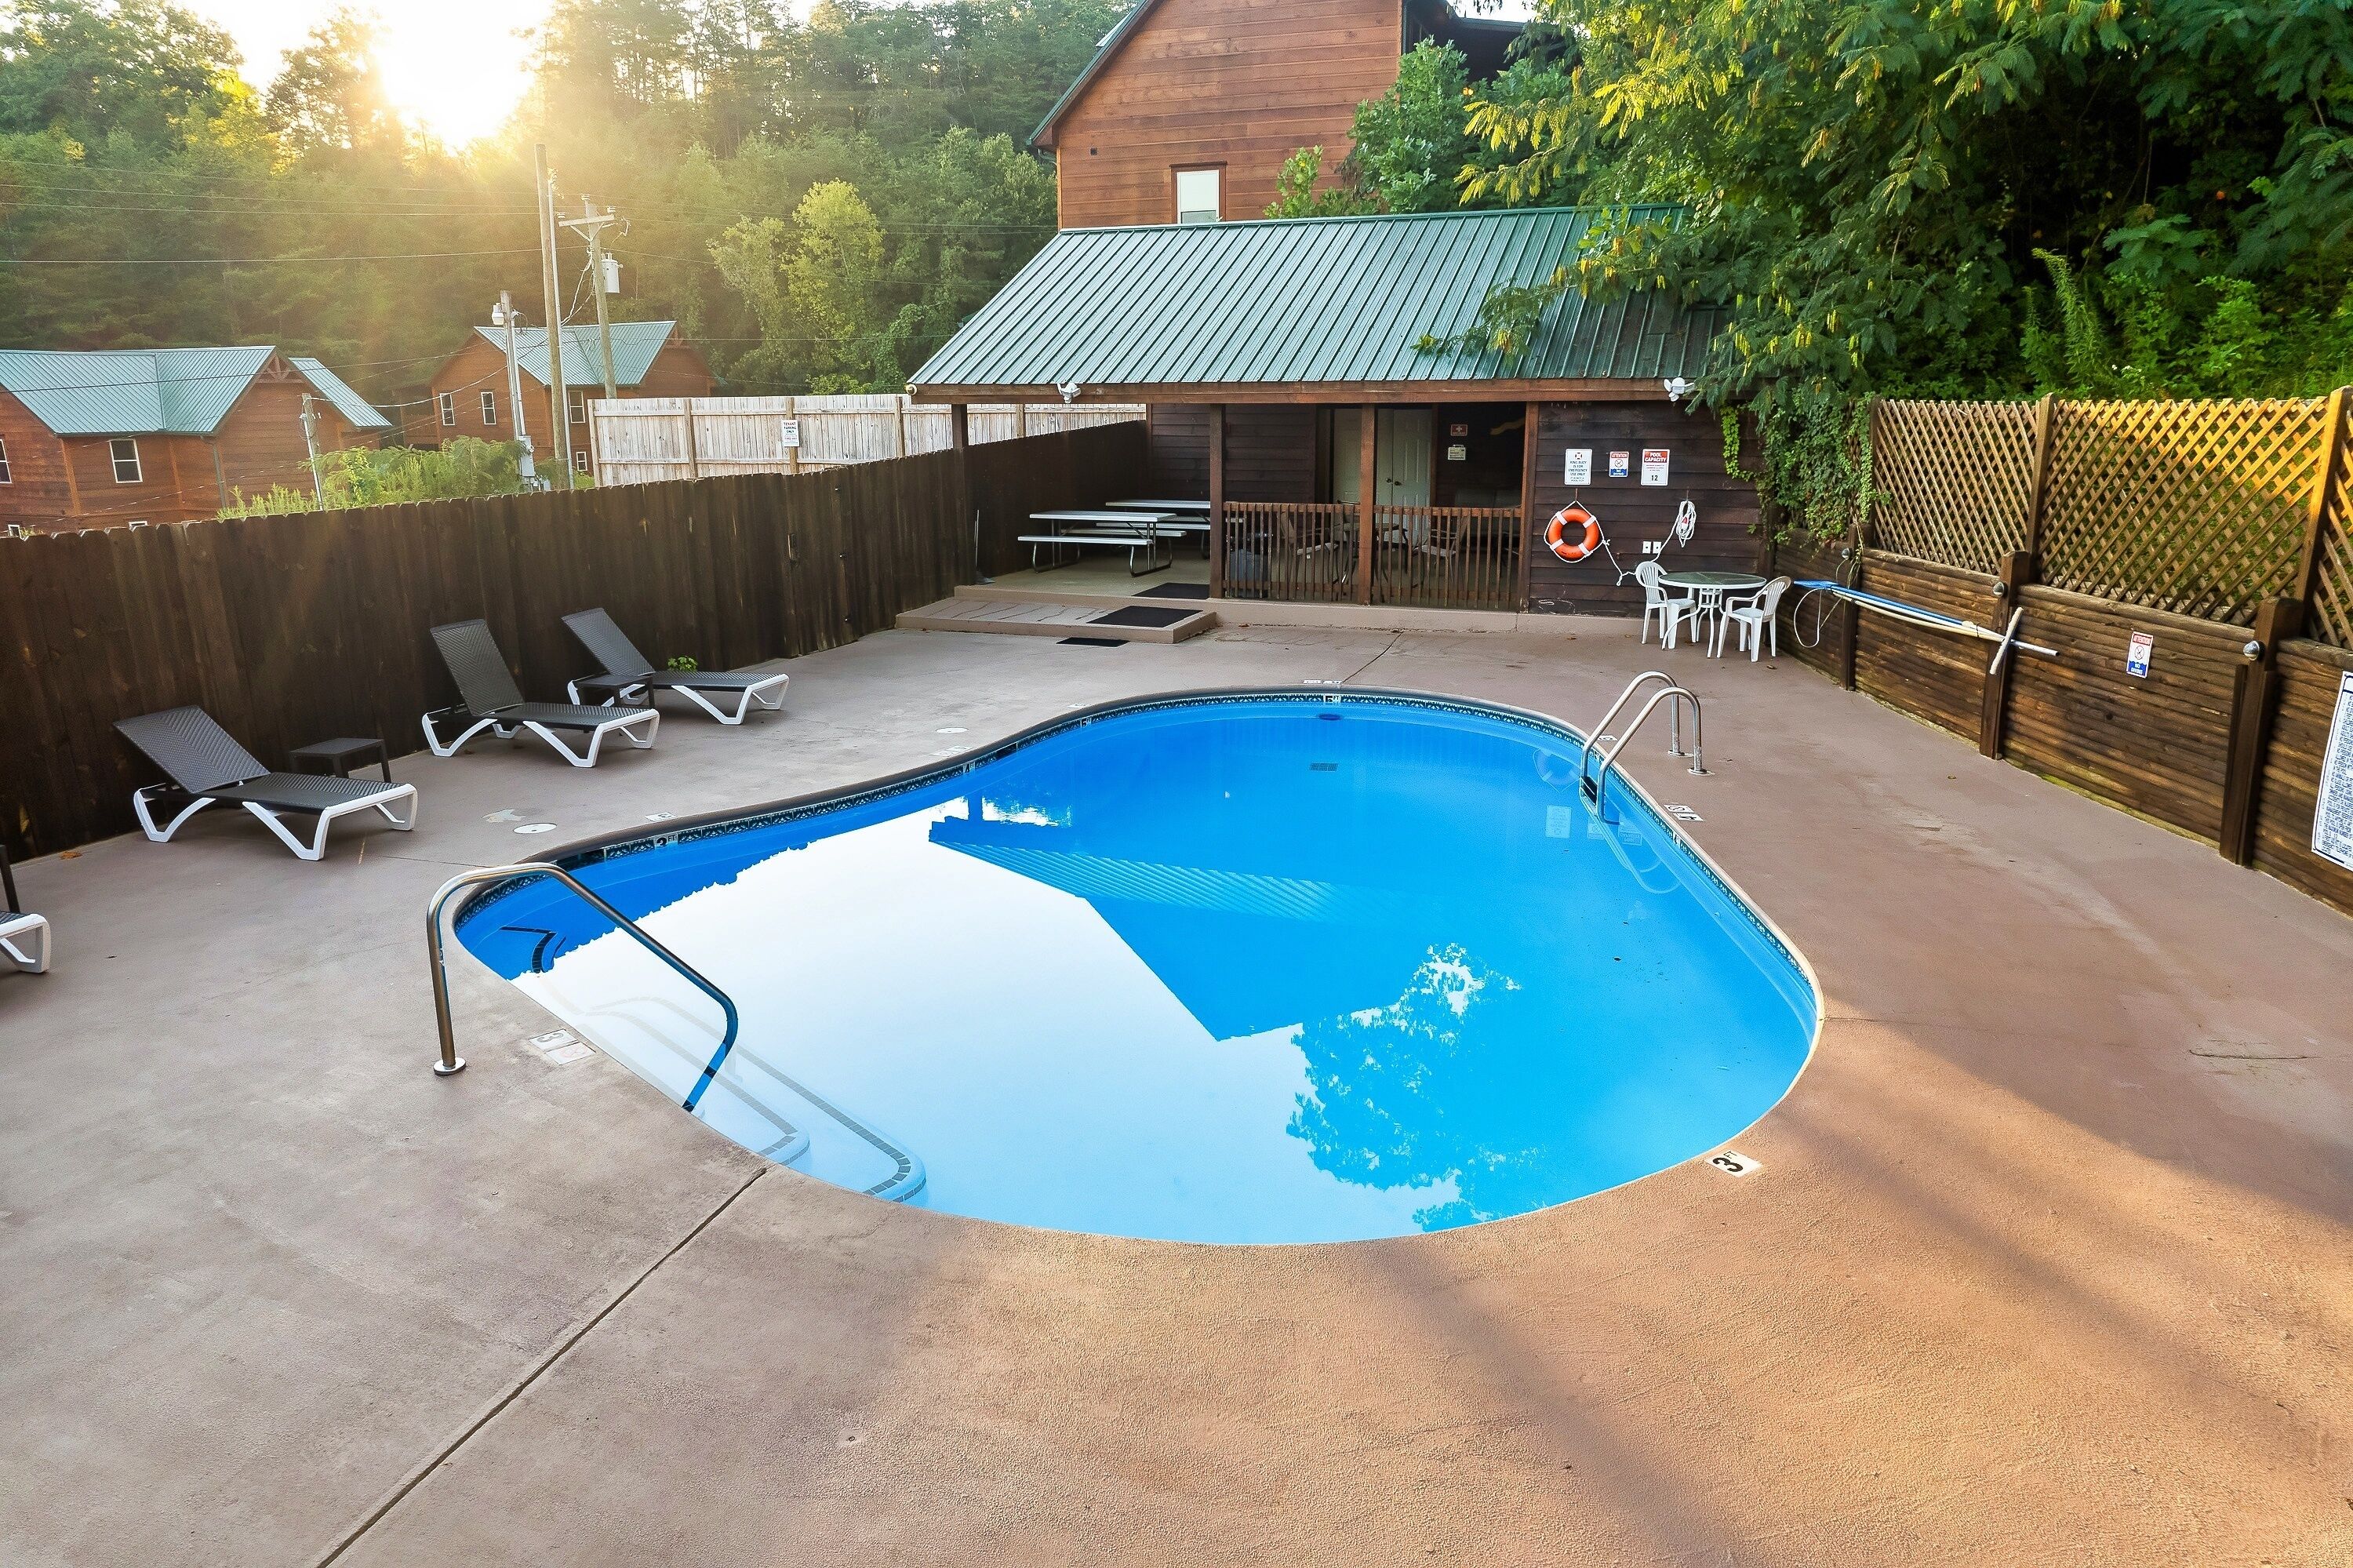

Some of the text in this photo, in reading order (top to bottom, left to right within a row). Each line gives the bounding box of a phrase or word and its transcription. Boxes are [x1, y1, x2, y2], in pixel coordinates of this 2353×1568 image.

[537, 1032, 564, 1043] 3
[1713, 1151, 1743, 1172] 3 FT
